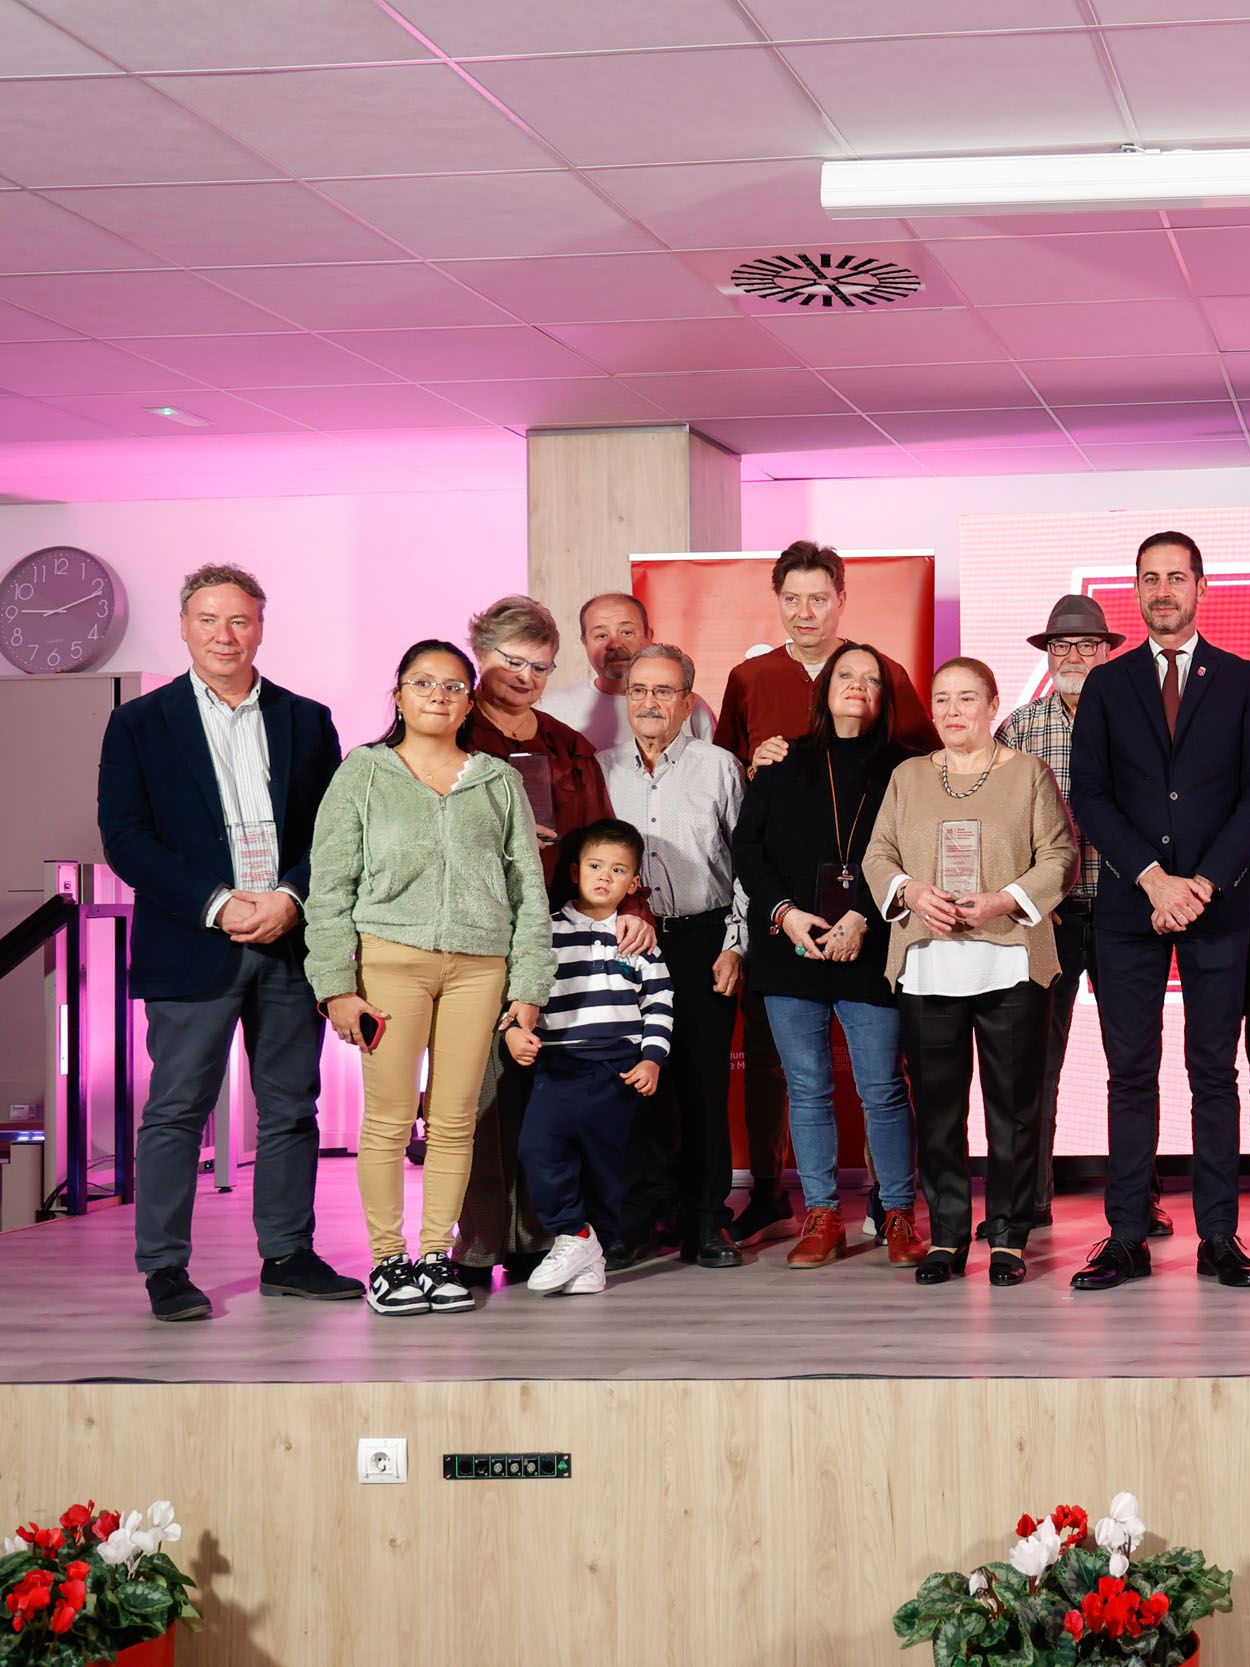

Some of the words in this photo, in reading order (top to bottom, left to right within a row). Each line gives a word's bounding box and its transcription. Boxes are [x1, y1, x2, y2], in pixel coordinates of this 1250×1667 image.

[33, 564, 47, 583] 11
[54, 558, 69, 575] 12
[14, 583, 34, 601] 10
[91, 577, 104, 594] 2
[5, 605, 18, 624] 9
[96, 599, 109, 618] 3
[10, 627, 23, 647] 8
[87, 623, 99, 641] 4
[27, 644, 40, 661] 7
[47, 648, 61, 667] 6
[70, 640, 83, 659] 5
